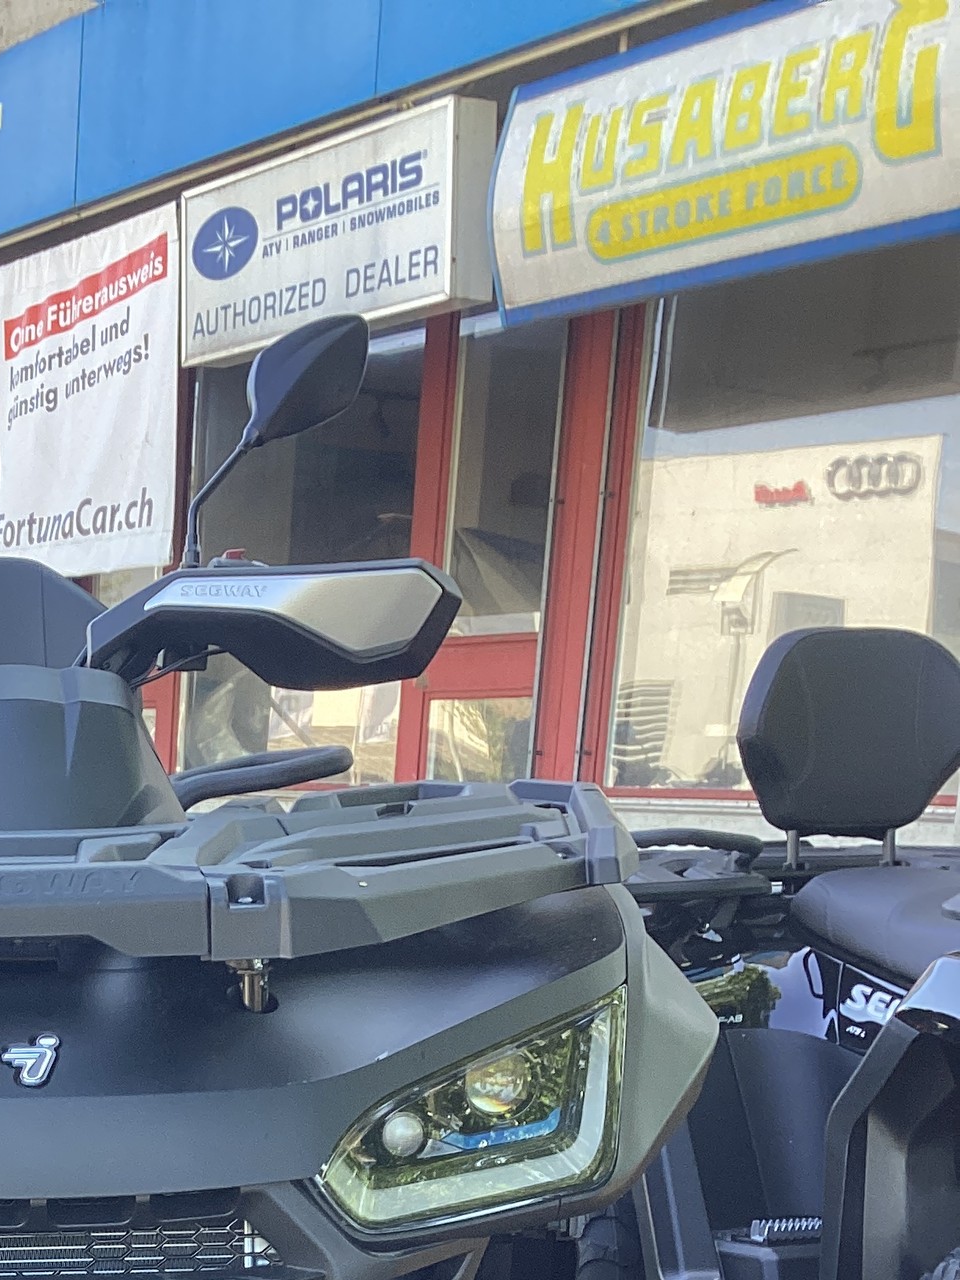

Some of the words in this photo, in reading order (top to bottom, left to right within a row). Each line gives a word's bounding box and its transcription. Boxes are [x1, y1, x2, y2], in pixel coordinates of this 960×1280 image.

[522, 0, 949, 258] HUSABERG
[262, 242, 282, 259] ATV
[292, 222, 338, 250] RANGER
[350, 190, 440, 232] SNOWMOBILES
[276, 150, 424, 231] POLARIS
[620, 188, 733, 242] STROKE
[744, 159, 849, 211] FORCE
[100, 306, 130, 346] und
[192, 277, 327, 340] AUTHORIZED
[345, 244, 439, 298] DEALER
[65, 333, 149, 399] unterwegs!
[180, 584, 268, 598] SEGWAY
